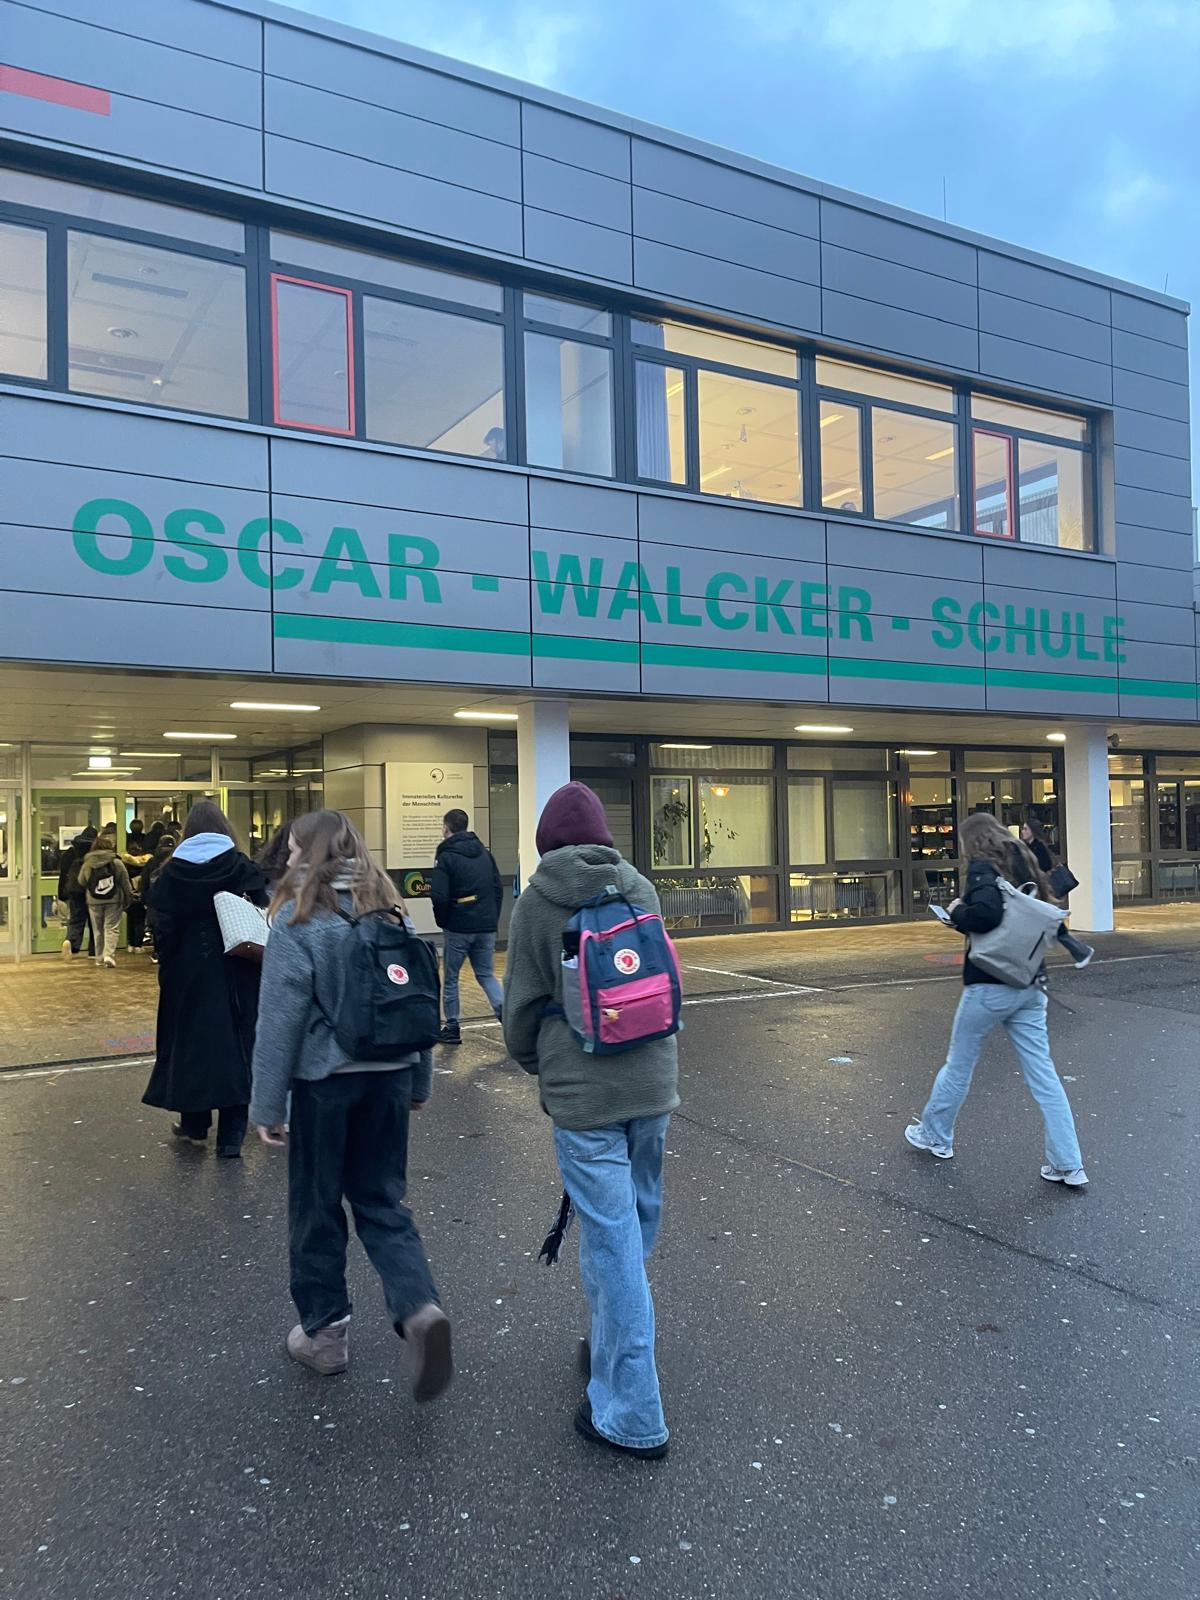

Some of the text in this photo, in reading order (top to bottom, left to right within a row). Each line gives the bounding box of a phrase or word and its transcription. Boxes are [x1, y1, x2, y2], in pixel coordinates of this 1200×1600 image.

[72, 498, 443, 605] OSCAR
[530, 549, 874, 643] WALCKER
[931, 596, 1128, 665] SCHULE
